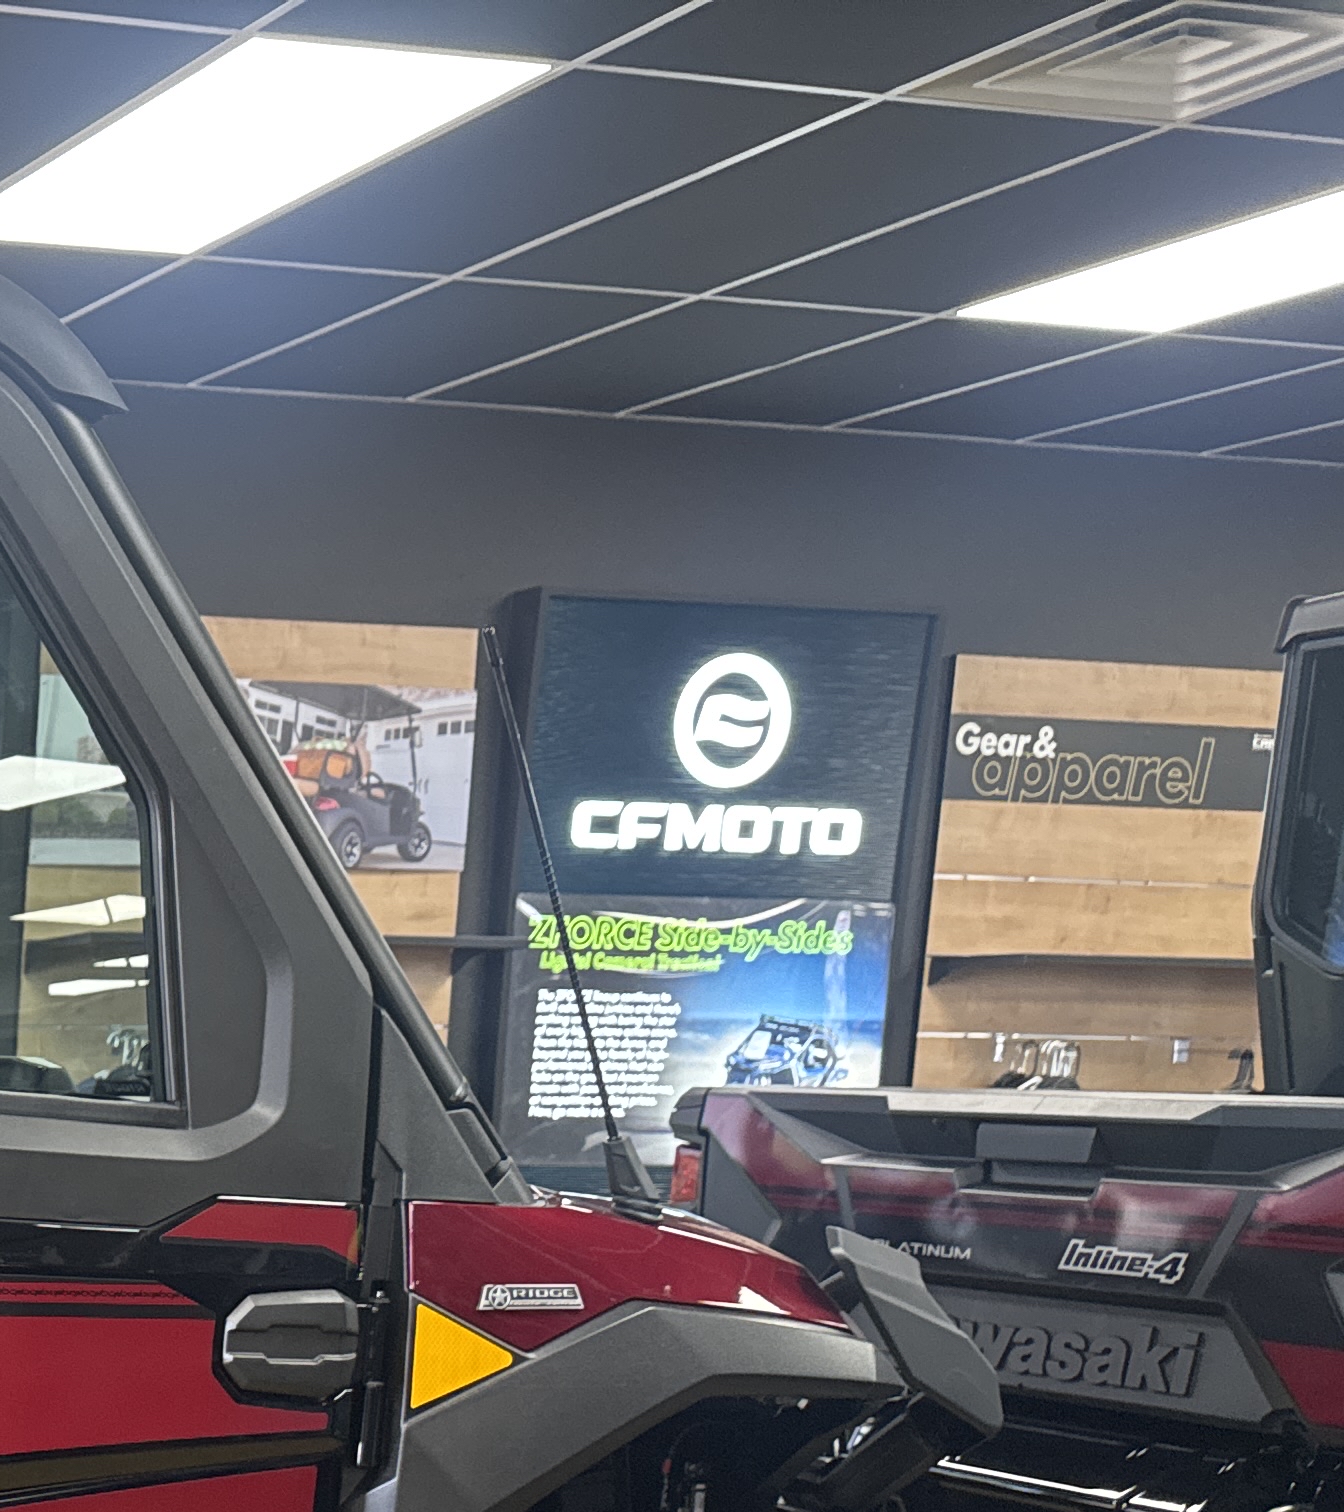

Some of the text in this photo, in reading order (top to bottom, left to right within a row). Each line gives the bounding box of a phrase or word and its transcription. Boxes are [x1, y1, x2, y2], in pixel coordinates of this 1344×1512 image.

[955, 721, 1031, 757] Gear
[972, 736, 1216, 804] apparel
[570, 800, 863, 856] CFMOTO
[654, 918, 854, 962] Side-by-Sides
[1058, 1239, 1189, 1285] Inline-4
[512, 1288, 576, 1299] RIDGE
[952, 1318, 1207, 1400] wasaki
